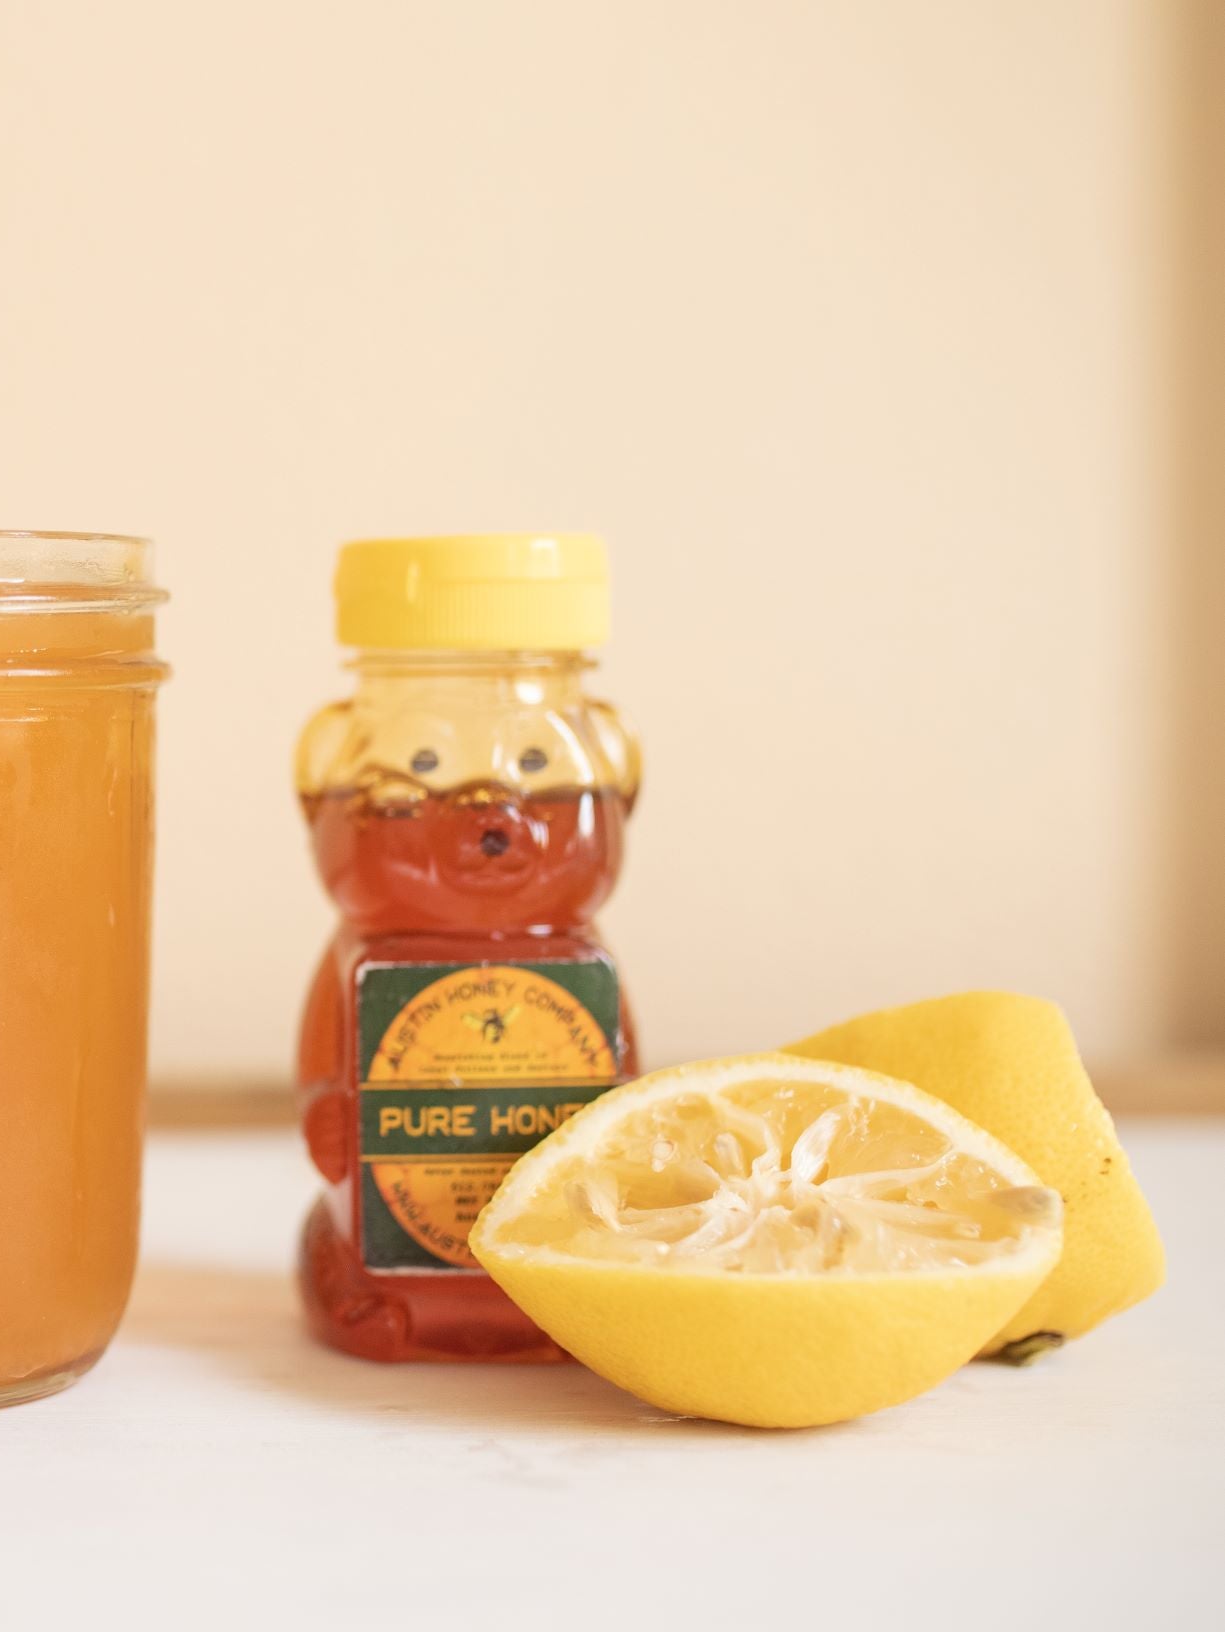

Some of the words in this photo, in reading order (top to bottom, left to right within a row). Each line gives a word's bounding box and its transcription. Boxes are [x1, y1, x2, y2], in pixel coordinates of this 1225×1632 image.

[388, 996, 442, 1073] AUSTIN
[445, 977, 517, 1007] HONEY
[524, 983, 599, 1068] COMPANY
[378, 1104, 478, 1138] PURE
[489, 1102, 585, 1137] HON
